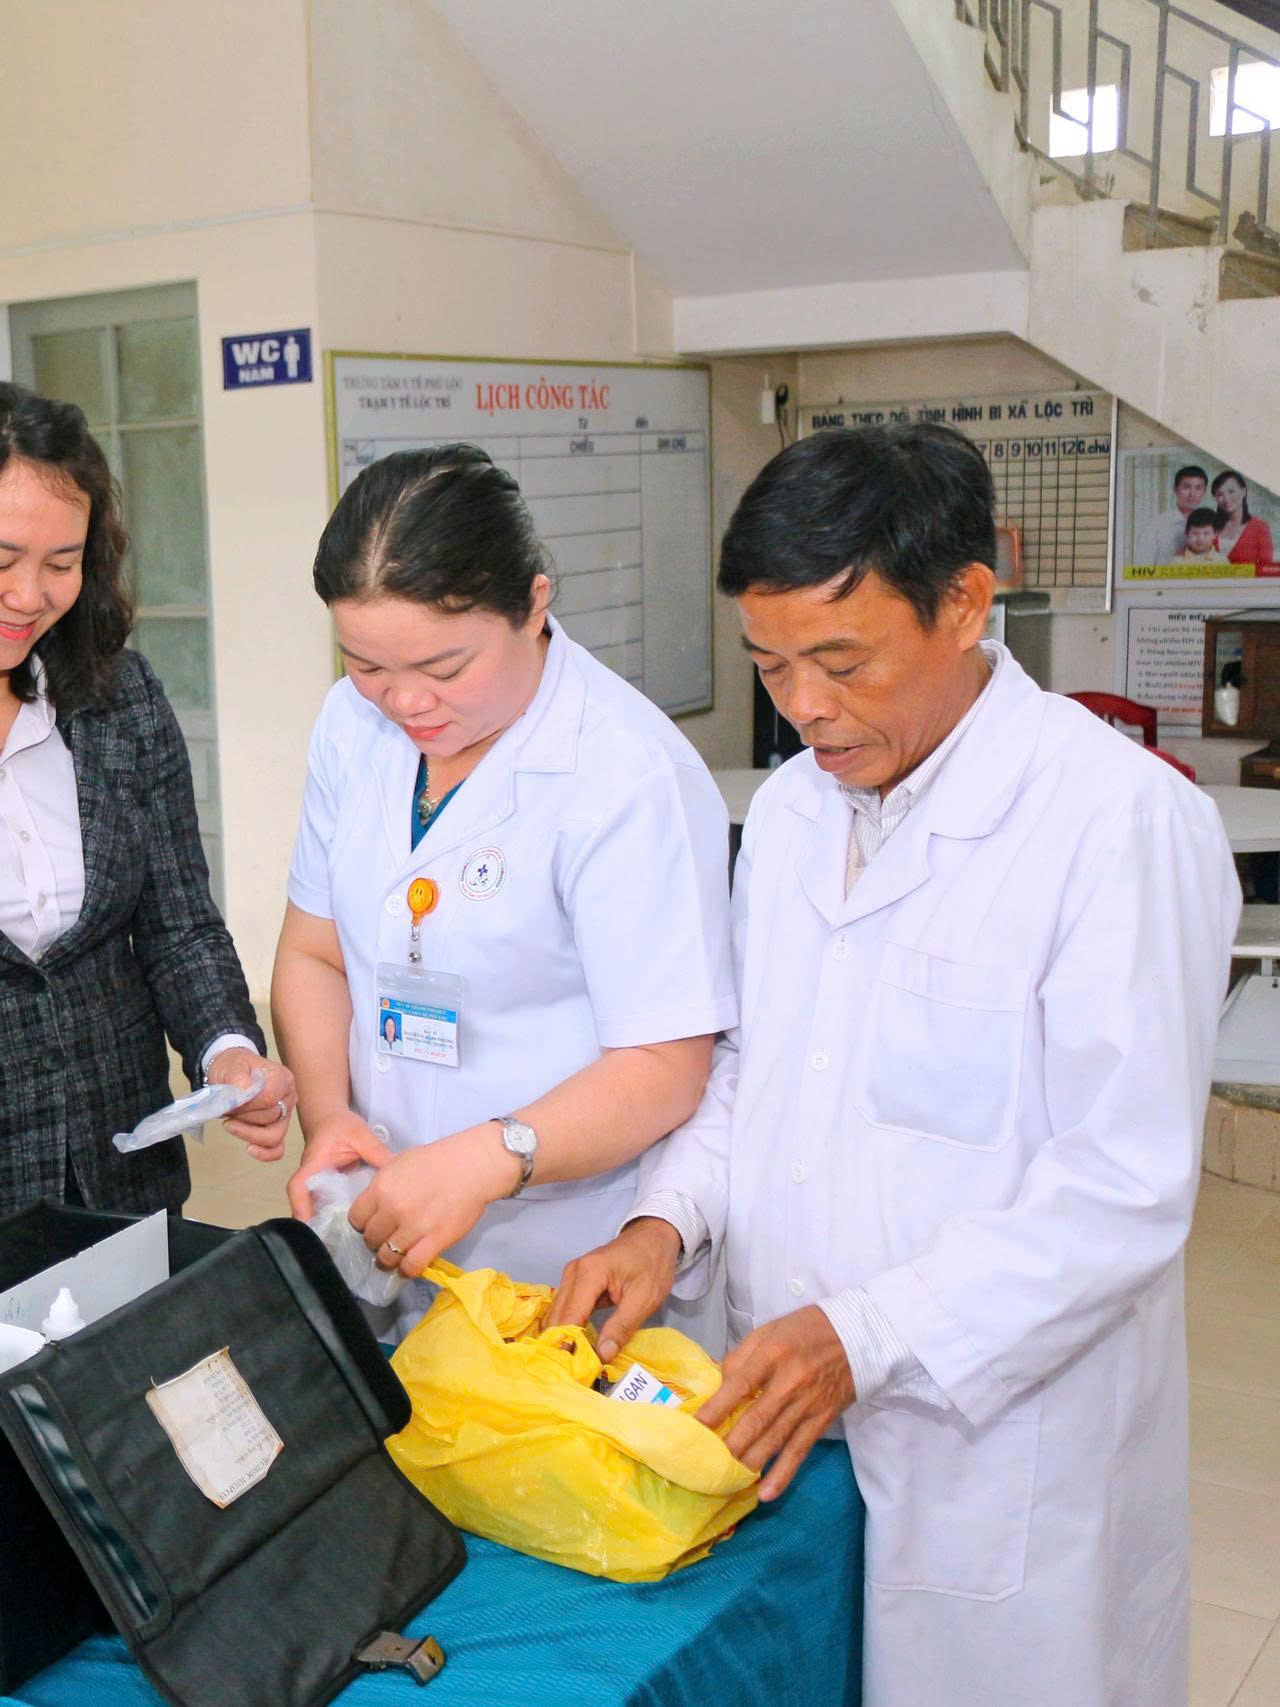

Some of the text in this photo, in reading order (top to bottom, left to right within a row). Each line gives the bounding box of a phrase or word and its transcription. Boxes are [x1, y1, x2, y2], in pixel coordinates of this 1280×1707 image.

[231, 339, 281, 366] WC
[238, 366, 274, 383] NAM
[476, 377, 610, 417] LỊCH CÔNG TÁC
[952, 402, 982, 421] HÌNH
[1008, 401, 1026, 419] XÃ
[1035, 400, 1063, 422] LỘC
[1072, 396, 1094, 416] TRÌ
[995, 443, 1004, 458] 8
[1012, 442, 1021, 457] 9
[1027, 442, 1041, 457] 10
[1045, 441, 1056, 457] 11
[1061, 440, 1076, 455] 12
[1132, 567, 1156, 577] HIV
